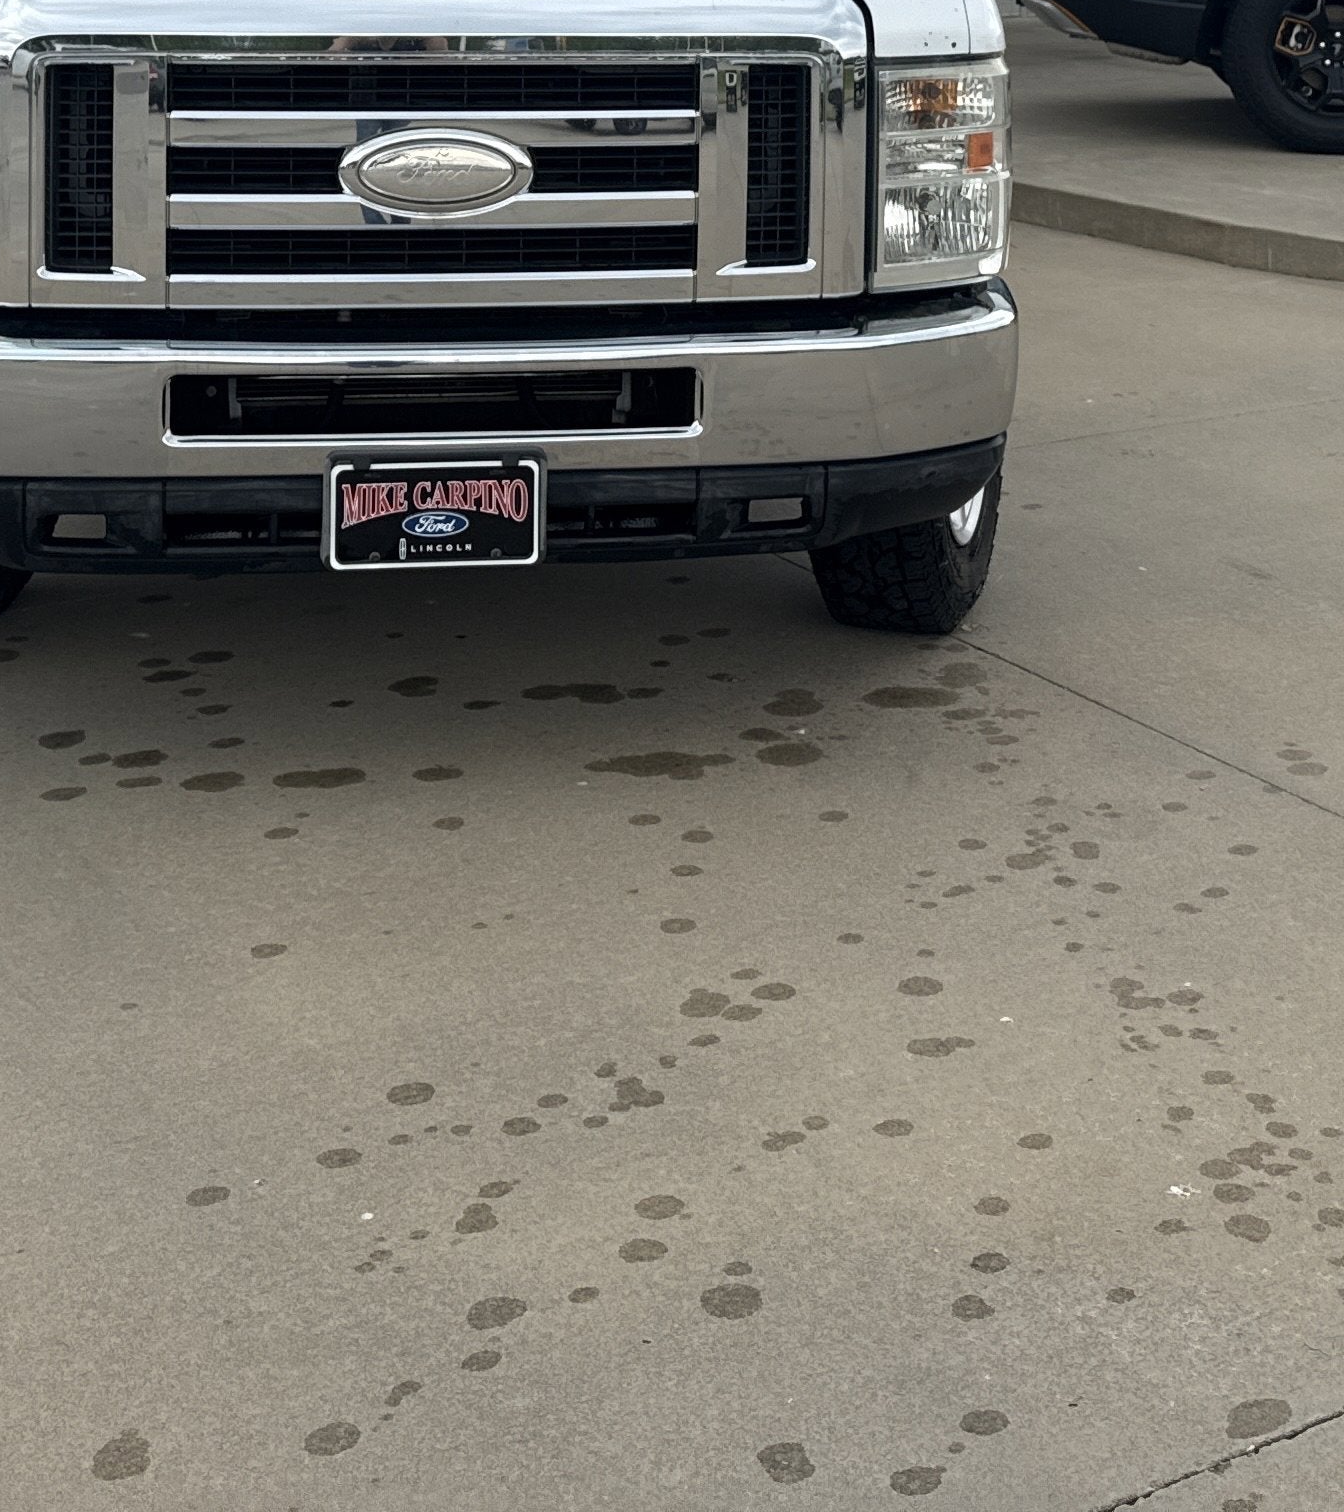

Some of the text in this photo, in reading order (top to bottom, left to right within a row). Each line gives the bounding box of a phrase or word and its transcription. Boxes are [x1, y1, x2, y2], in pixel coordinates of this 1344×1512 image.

[396, 155, 473, 185] Ford
[341, 479, 528, 529] MIKE CARPINO
[414, 515, 456, 533] Ford
[410, 543, 472, 553] LINCOLN
